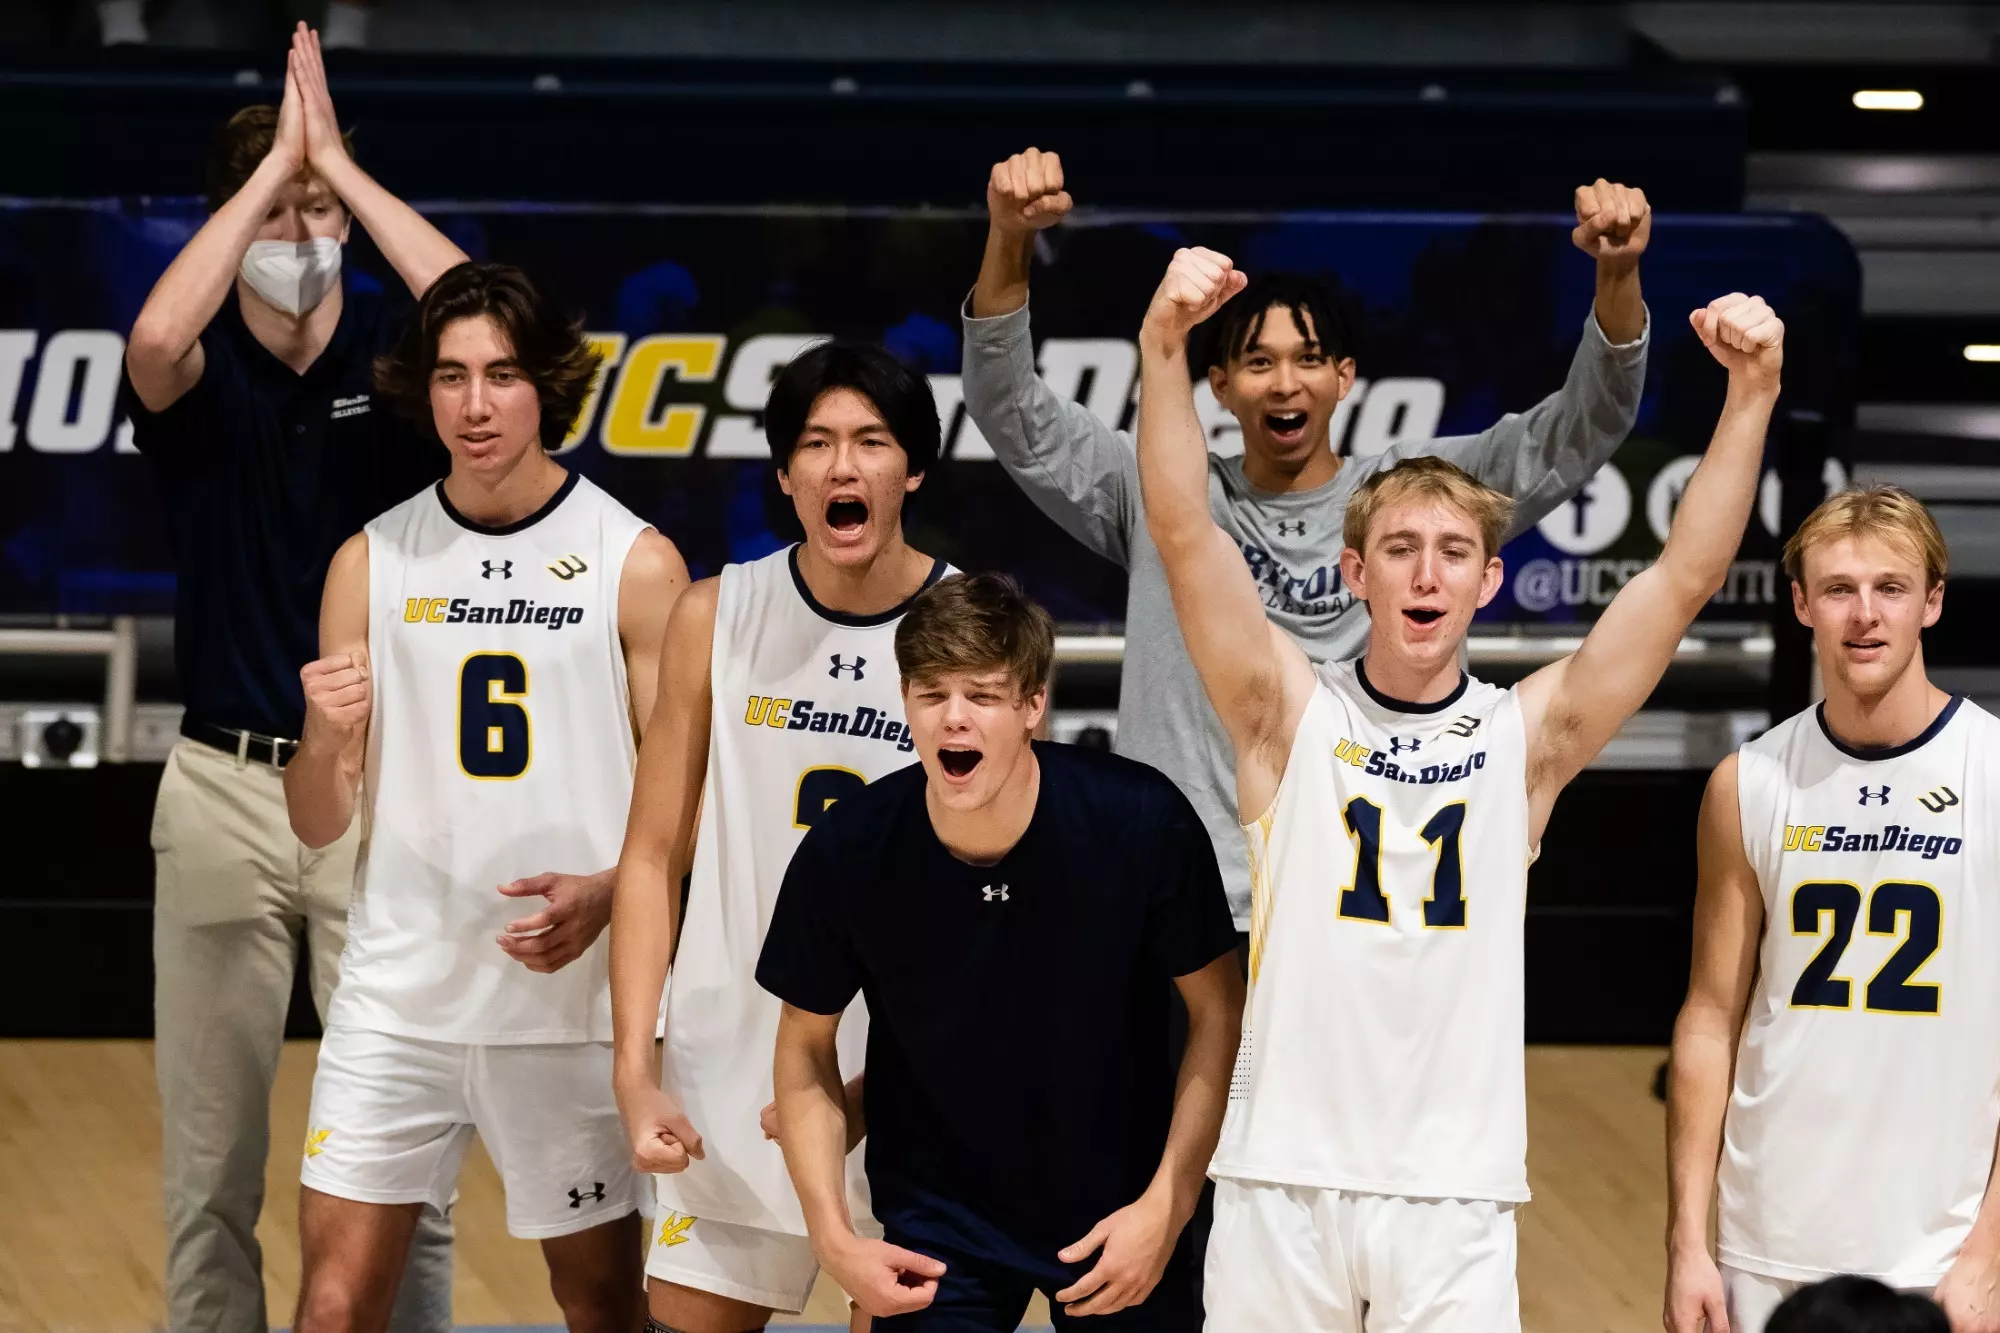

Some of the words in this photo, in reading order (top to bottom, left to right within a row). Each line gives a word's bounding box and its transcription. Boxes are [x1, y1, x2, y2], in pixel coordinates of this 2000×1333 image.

[456, 650, 533, 781] 6
[744, 695, 915, 753] UCSanDieg
[1336, 794, 1469, 930] 11
[1788, 879, 1944, 1017] 22
